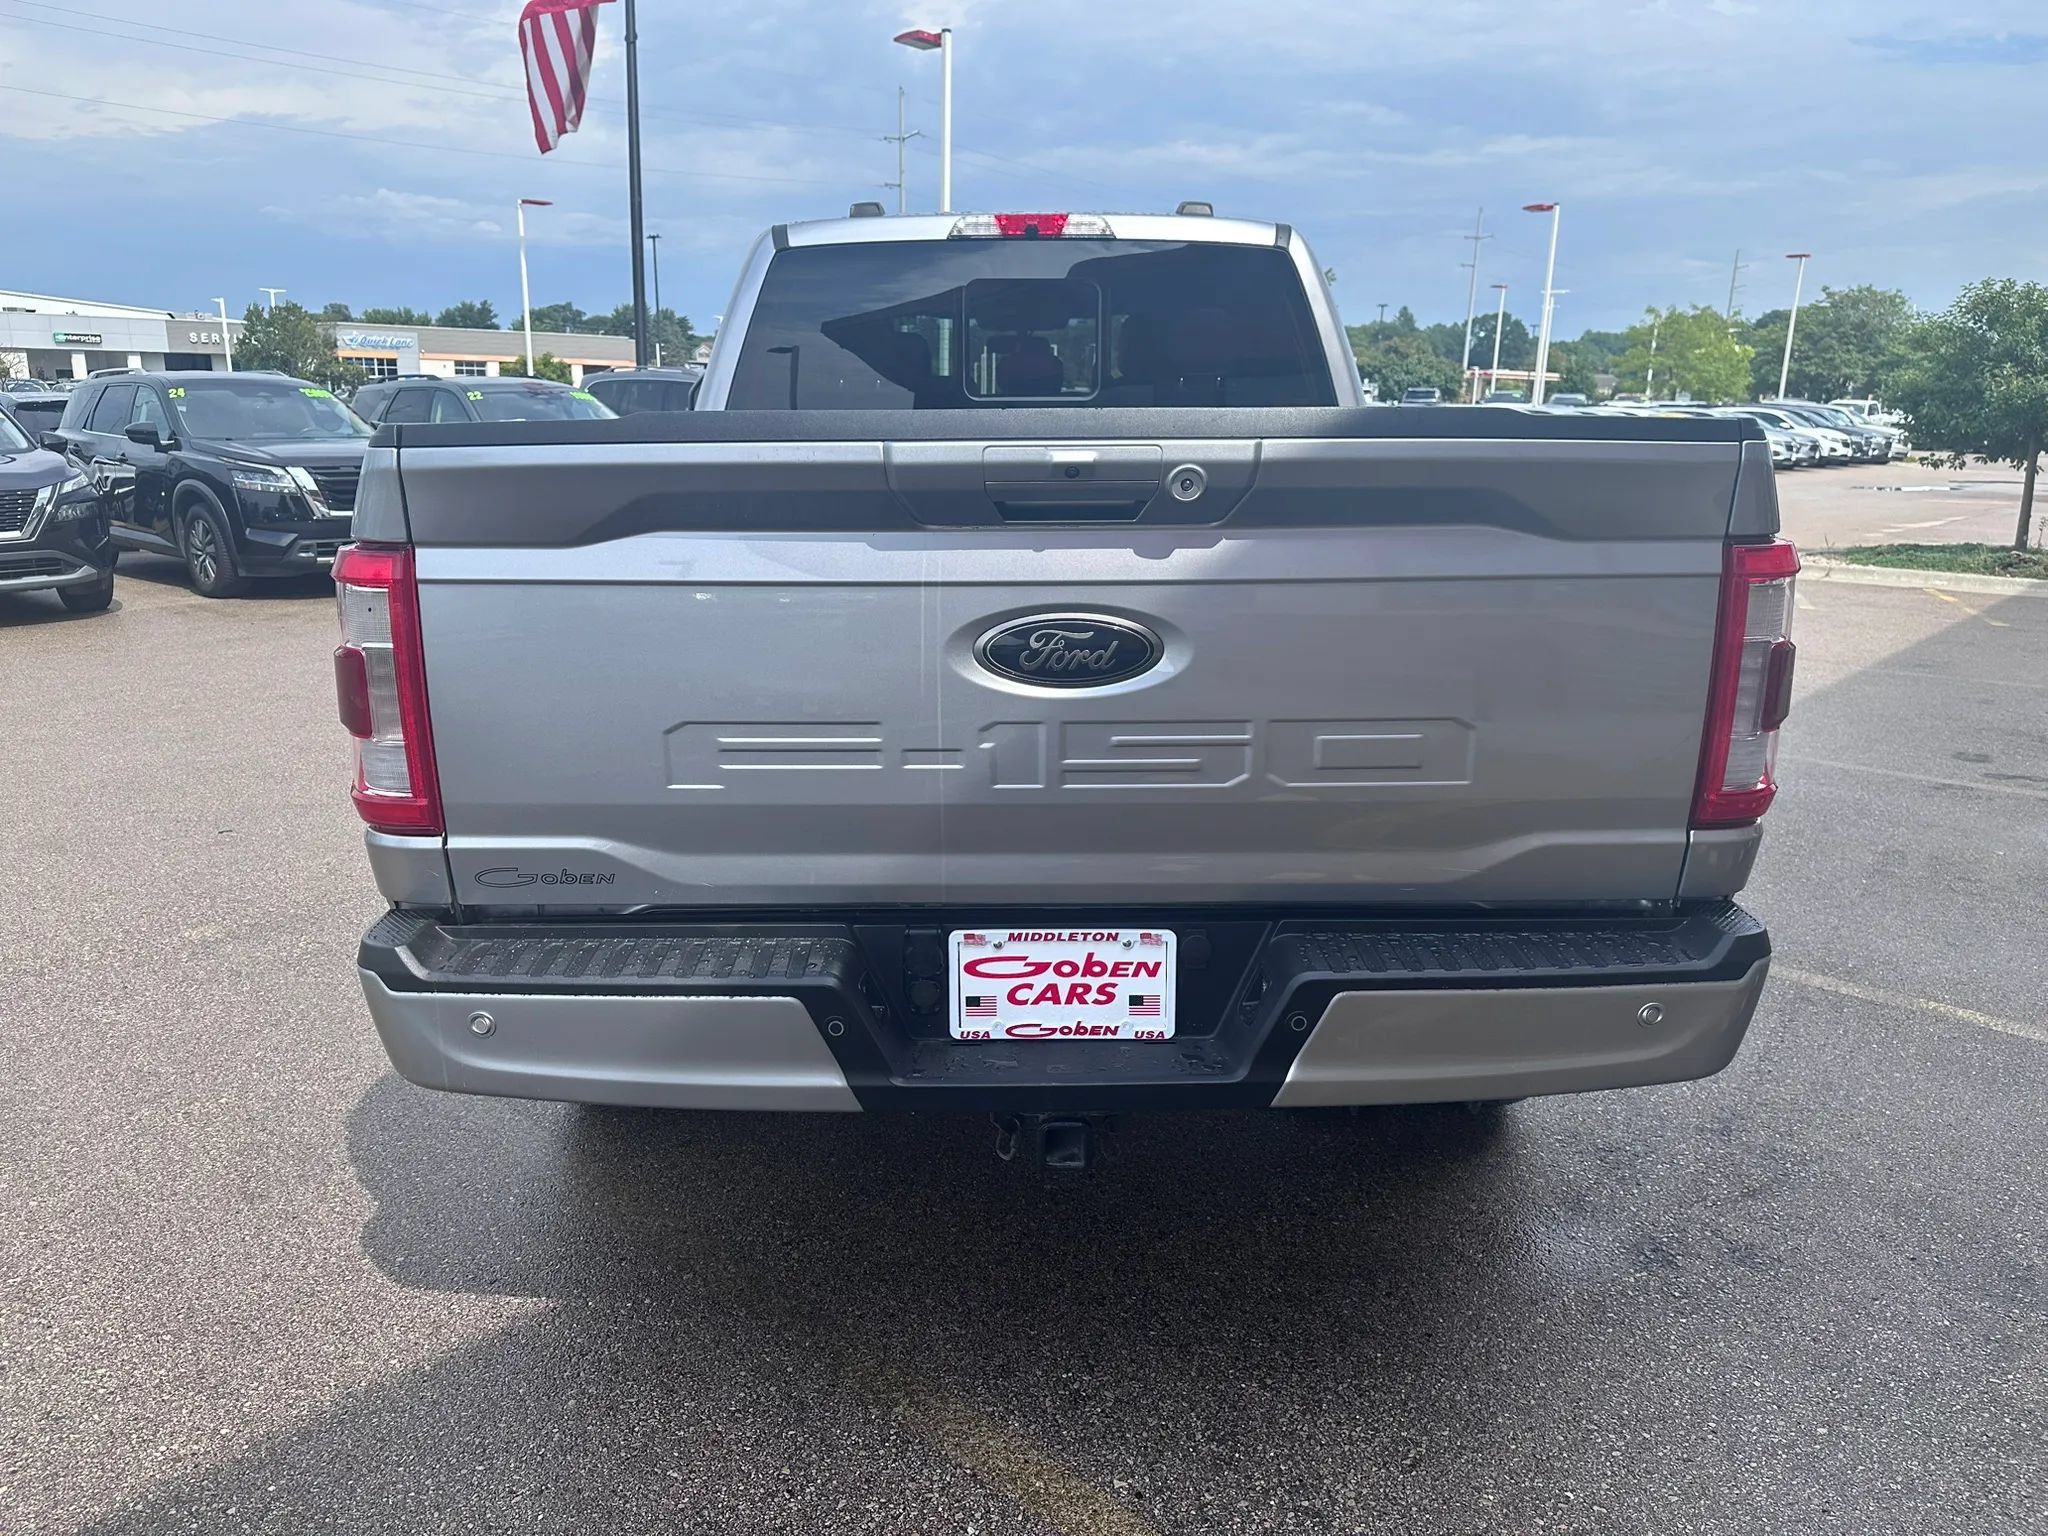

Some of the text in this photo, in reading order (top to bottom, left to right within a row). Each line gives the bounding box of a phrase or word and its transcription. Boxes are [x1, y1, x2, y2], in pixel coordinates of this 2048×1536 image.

[168, 387, 185, 398] 24
[466, 391, 483, 401] 22
[1018, 629, 1119, 672] Ford
[663, 718, 1477, 790] F-150
[1007, 932, 1120, 942] MIDDLETON
[1006, 982, 1119, 1006] CARS
[960, 1030, 991, 1039] USA
[1134, 1030, 1165, 1039] USA
